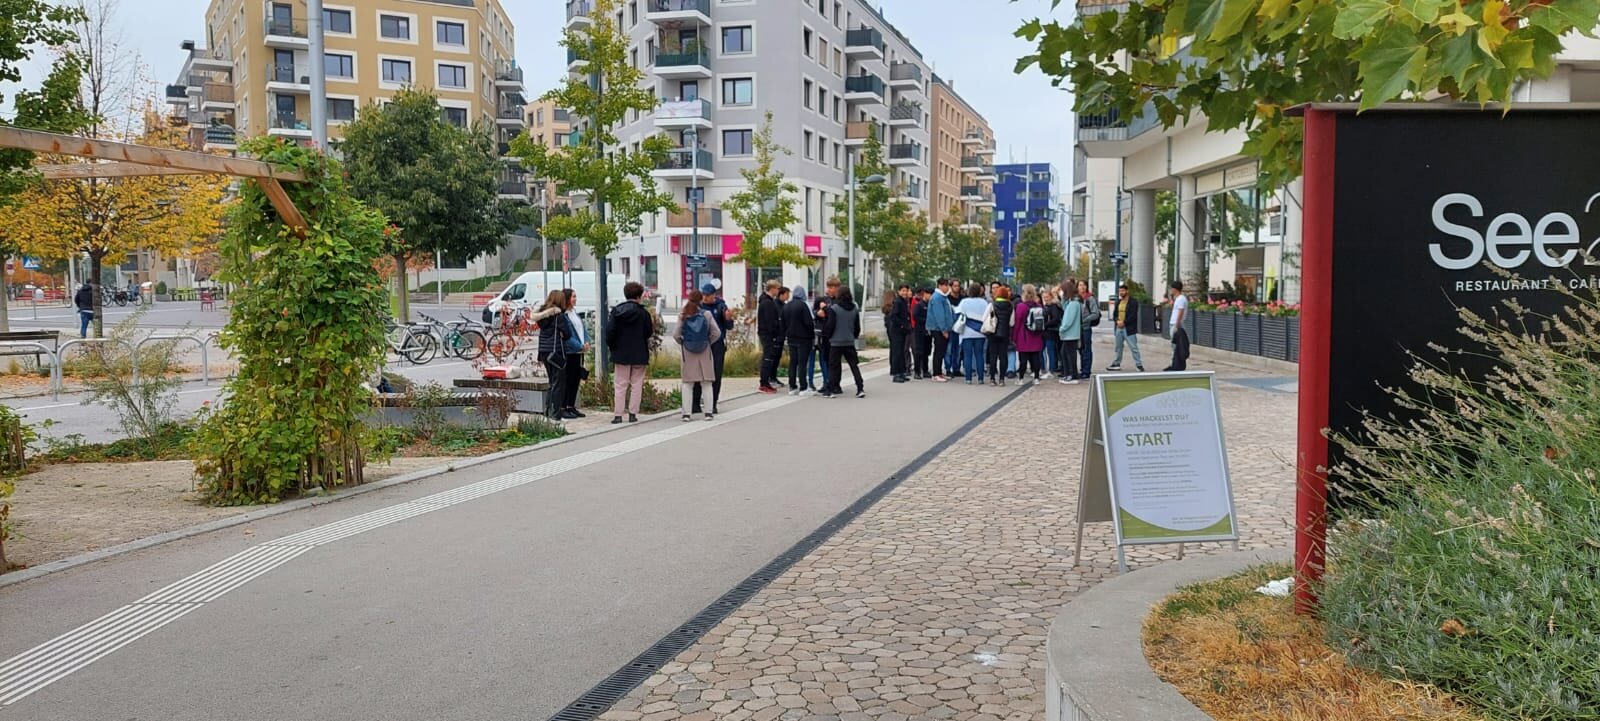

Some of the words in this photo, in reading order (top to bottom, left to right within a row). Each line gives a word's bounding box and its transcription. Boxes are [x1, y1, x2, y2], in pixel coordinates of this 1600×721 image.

[1455, 279, 1549, 292] RESTAURANT
[1569, 278, 1600, 290] CAF
[1139, 414, 1173, 422] HACKELST
[1125, 432, 1172, 447] START
